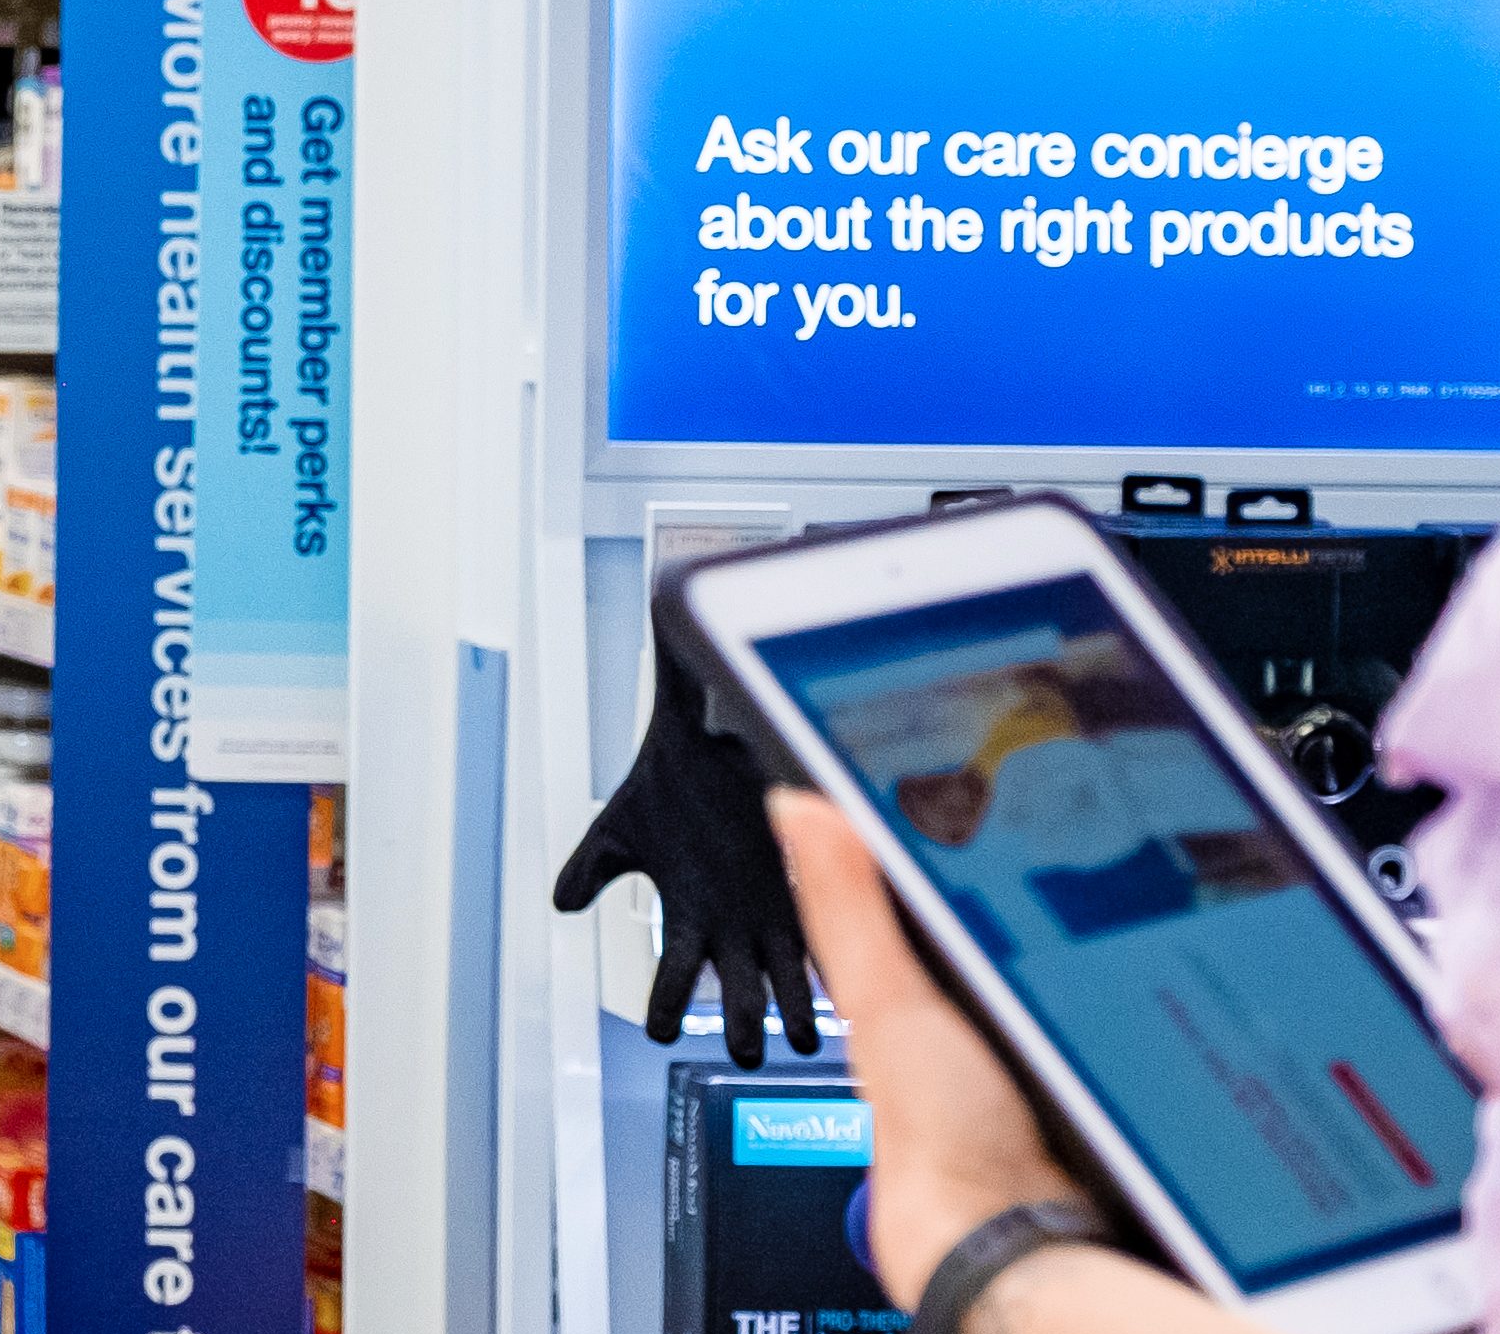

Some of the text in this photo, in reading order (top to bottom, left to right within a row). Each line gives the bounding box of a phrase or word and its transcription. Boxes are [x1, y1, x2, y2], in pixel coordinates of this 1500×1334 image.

[300, 94, 345, 185] Get
[696, 114, 1384, 196] Ask our care concierge
[237, 94, 285, 456] and discounts!
[297, 197, 341, 406] member
[697, 193, 1414, 269] about the right products
[693, 269, 916, 342] for you.
[288, 417, 338, 558] perks
[150, 446, 197, 762] services
[148, 780, 215, 962] from
[147, 984, 199, 1117] our
[143, 1134, 198, 1308] care
